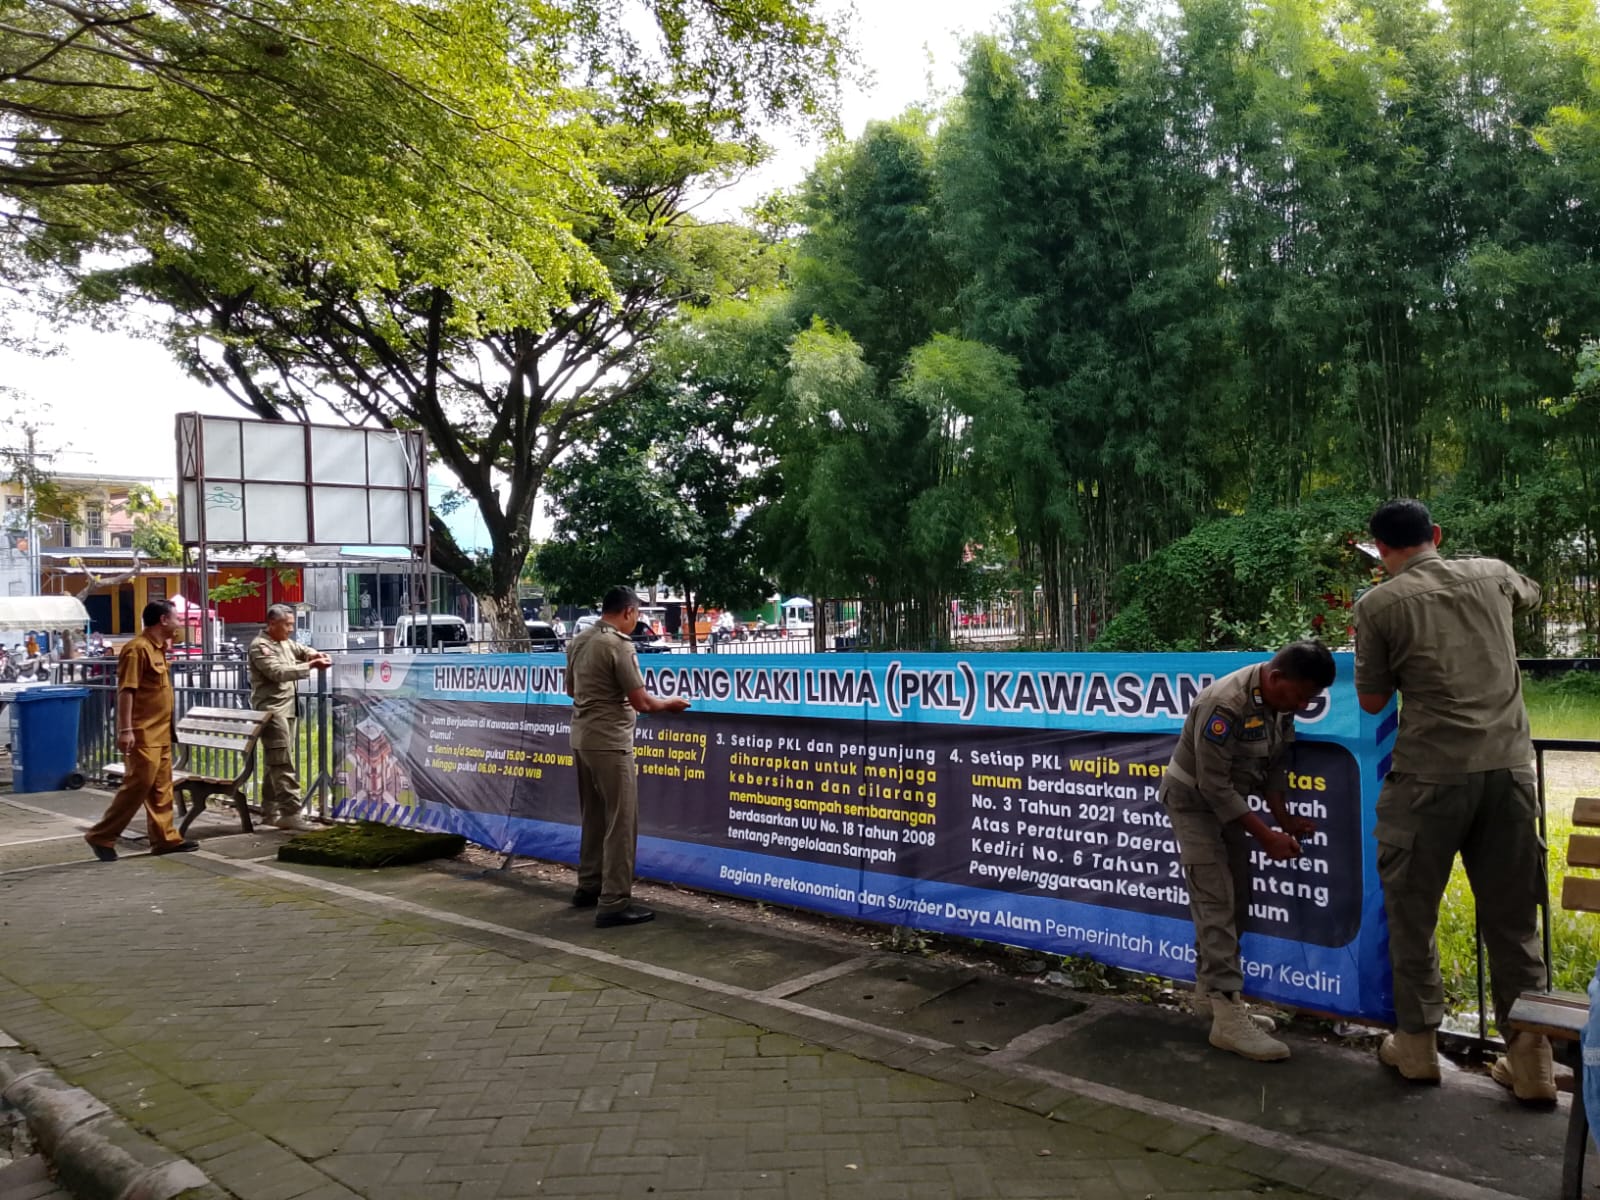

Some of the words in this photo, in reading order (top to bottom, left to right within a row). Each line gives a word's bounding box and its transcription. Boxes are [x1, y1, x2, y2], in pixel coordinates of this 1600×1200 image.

[434, 666, 526, 692] HIMBAUAN
[530, 667, 568, 695] UNT
[645, 667, 729, 700] AGANG
[734, 669, 799, 702] KAKI
[805, 669, 879, 707] LIMA
[885, 661, 977, 719] (PKL)
[431, 716, 445, 725] Jam
[446, 716, 478, 729] Berjualan
[479, 717, 485, 728] di
[486, 718, 518, 730] Kawasan
[520, 720, 555, 736] Simpang
[556, 721, 571, 734] Lim
[635, 728, 654, 740] PKL
[658, 729, 706, 748] dilarang
[434, 744, 453, 755] Senin
[453, 744, 465, 757] s/d
[465, 746, 485, 758] Sabtu
[485, 749, 506, 761] pukul
[506, 750, 525, 761] 15.00
[532, 752, 556, 764] 24.00
[557, 755, 574, 766] WIB
[668, 747, 697, 763] lapak
[716, 733, 725, 745] 3.
[730, 734, 773, 752] Setiap
[778, 737, 801, 751] PKL
[807, 739, 833, 754] dan
[840, 744, 936, 766] pengunjung
[950, 750, 963, 763] 4.
[970, 750, 1024, 771] Setiap
[1032, 754, 1062, 770] PKL
[1069, 756, 1120, 778] wajib
[431, 758, 456, 773] Minggu
[457, 761, 477, 773] pukul
[478, 762, 497, 774] 06.00
[503, 765, 524, 777] 24.00
[525, 767, 542, 779] WIB
[642, 763, 680, 777] setelah
[684, 765, 705, 781] jam
[730, 752, 809, 772] diharapkan
[815, 760, 857, 776] untuk
[865, 765, 937, 786] menjaga
[730, 771, 814, 791] kebersihan
[821, 780, 850, 795] dan
[858, 783, 936, 808] dilarang
[972, 774, 1022, 790] umum
[1027, 776, 1137, 800] berdasarkan
[729, 791, 792, 812] membuang
[794, 797, 842, 815] sampah
[844, 803, 936, 827] sembarangan
[972, 793, 997, 810] No.
[1003, 796, 1012, 811] 3
[1019, 798, 1071, 818] Tahun
[1079, 803, 1115, 822] 2021
[1123, 809, 1172, 828] tenta
[729, 807, 798, 829] berdasarkan
[801, 817, 817, 831] UU
[820, 819, 839, 834] No.
[842, 821, 854, 836] 18
[858, 824, 899, 842] Tahun
[902, 830, 936, 847] 2008
[971, 816, 1009, 834] Atas
[1017, 820, 1108, 846] Peraturan
[728, 826, 769, 847] tentang
[771, 834, 842, 855] Pengelolaan
[843, 843, 896, 863] Sampah
[971, 837, 1024, 859] Kediri
[1033, 846, 1064, 864] No.
[1073, 850, 1083, 866] 6
[1092, 853, 1159, 876] Tahun
[969, 860, 1114, 891] Penyelenggaraan
[1116, 879, 1190, 906] Ketertib
[720, 865, 762, 886] Bagian
[764, 872, 855, 903] Perekonomian
[857, 890, 886, 908] dan
[888, 895, 942, 916] Sumber
[944, 903, 990, 927] Daya
[993, 910, 1041, 934] Alam
[1045, 919, 1153, 955] Pemerintah
[1279, 965, 1341, 995] Kediri
